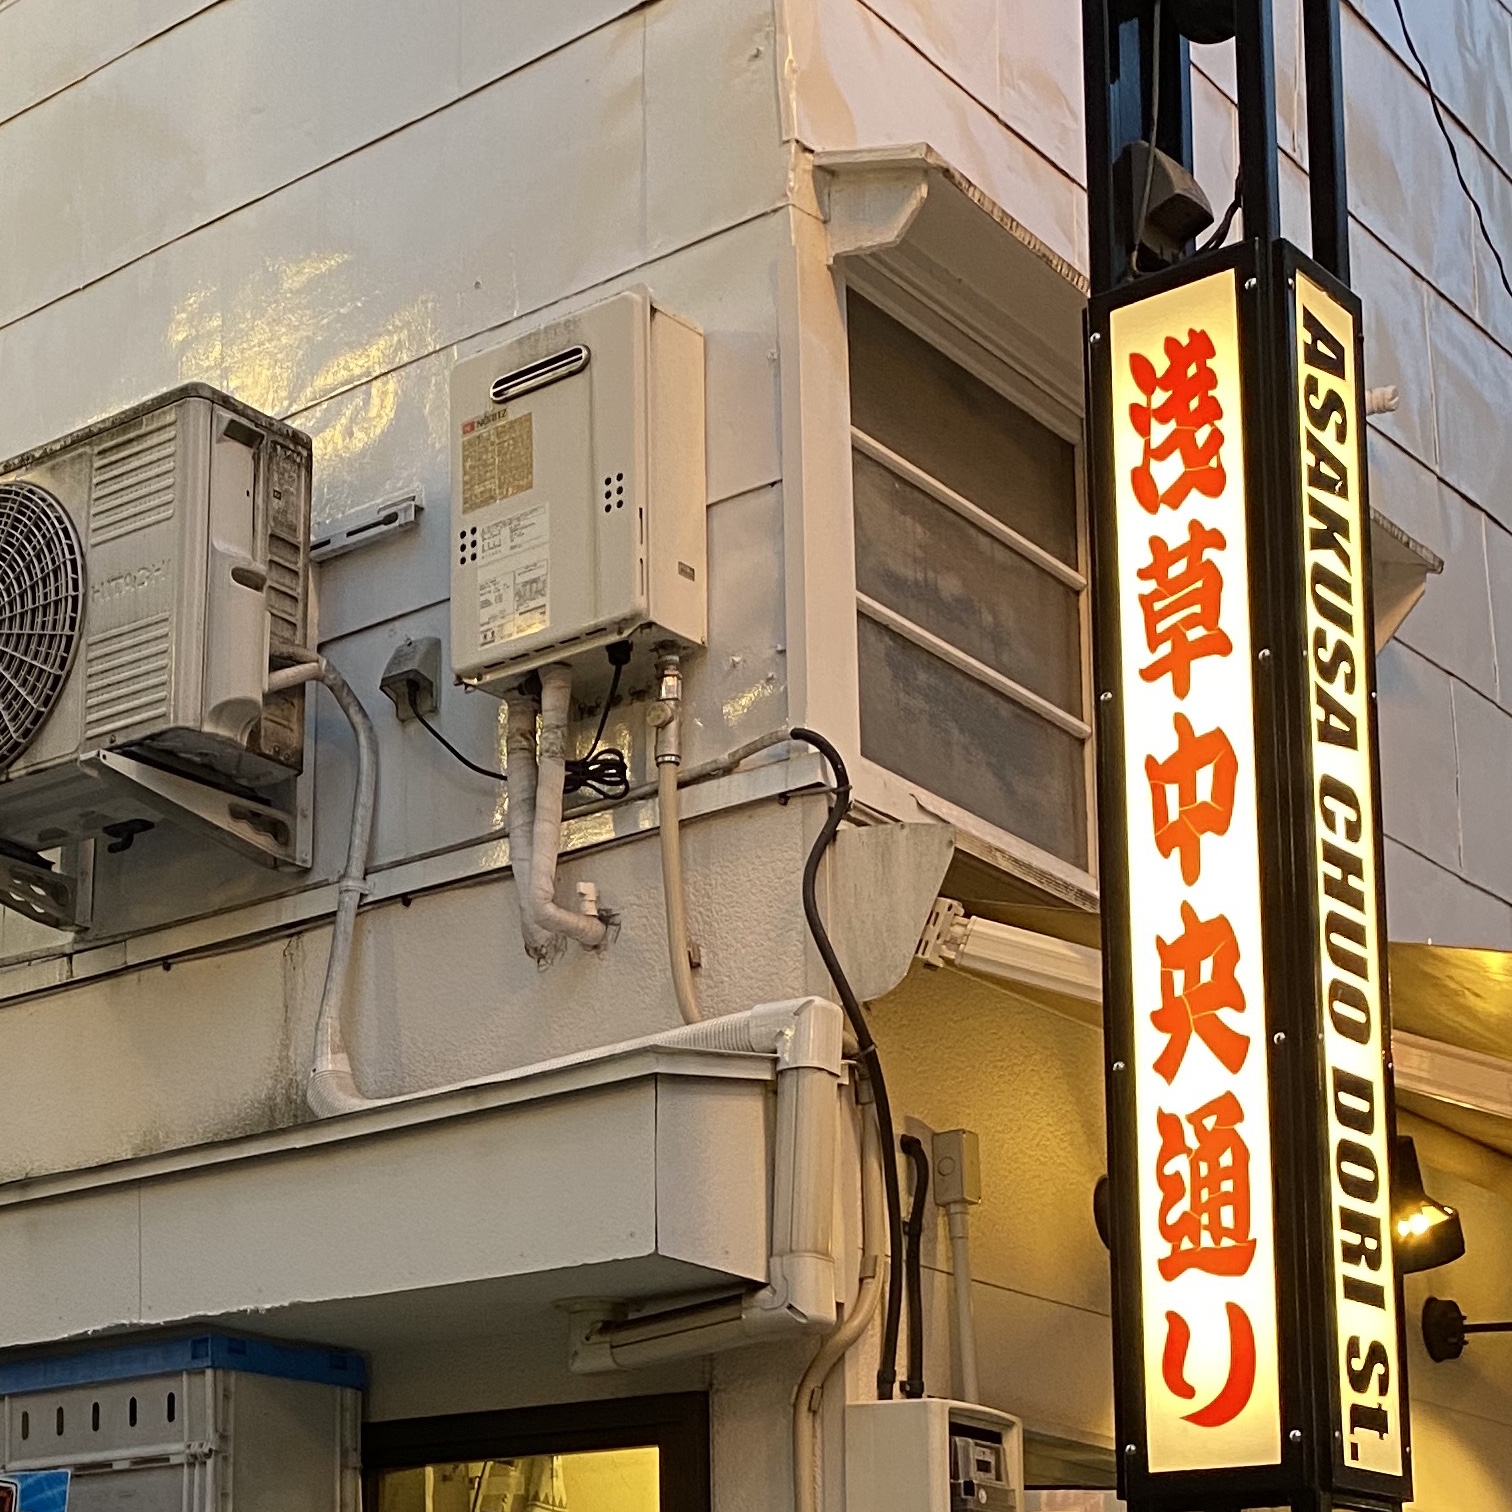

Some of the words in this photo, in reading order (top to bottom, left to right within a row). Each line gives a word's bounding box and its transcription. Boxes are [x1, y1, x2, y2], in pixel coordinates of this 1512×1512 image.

[1301, 306, 1357, 747] ASAKUSA
[1129, 327, 1256, 1427] 浅草中央通り
[1317, 776, 1374, 1042] CHUO
[1323, 1075, 1385, 1316] DORI
[1345, 1334, 1390, 1464] St.
